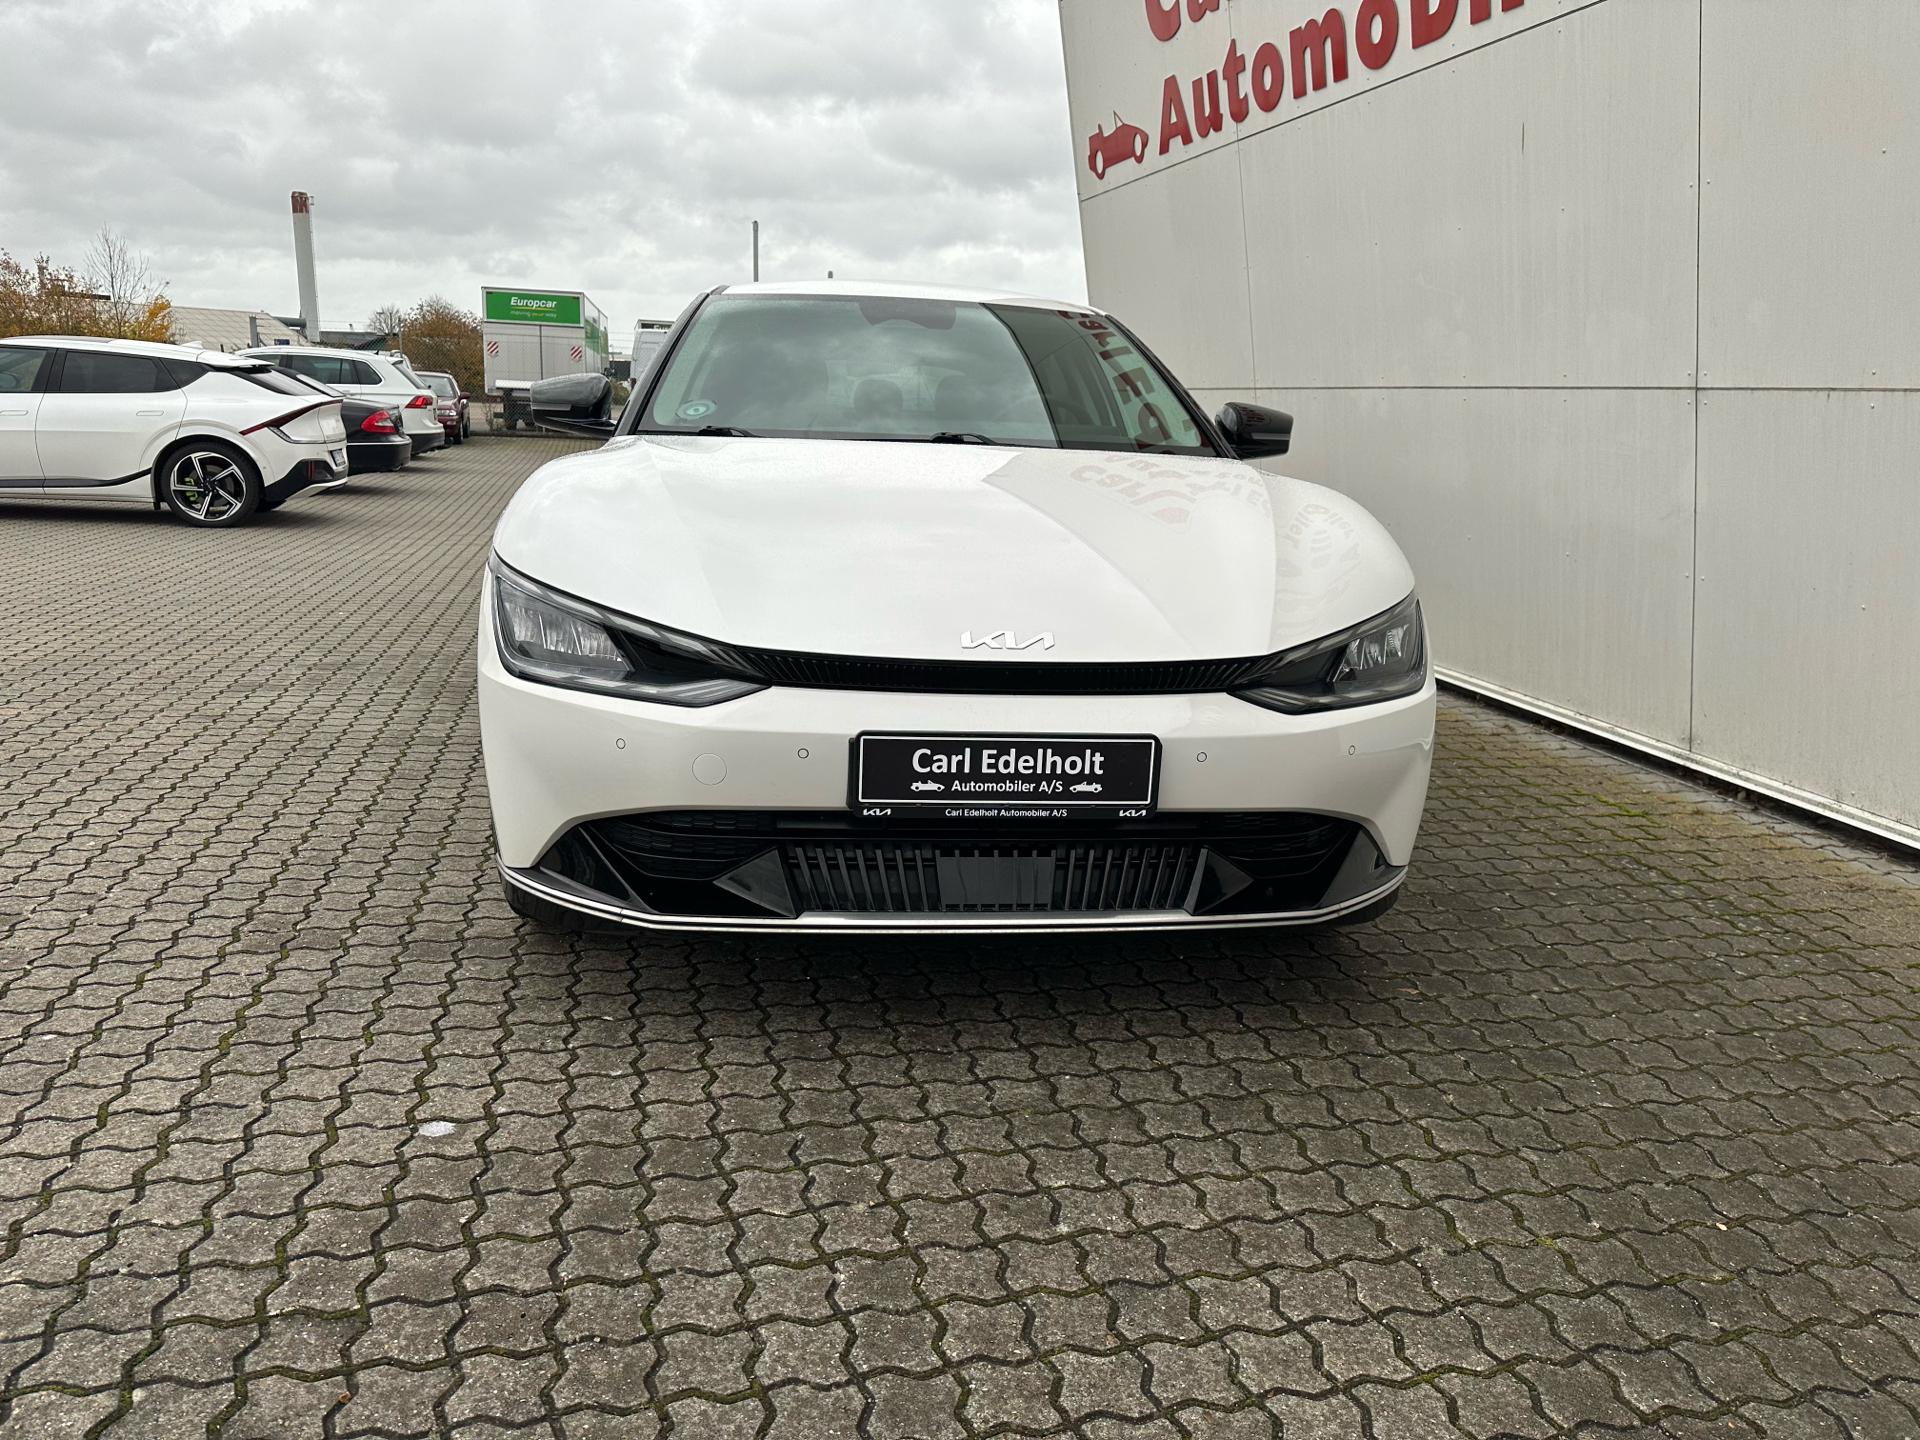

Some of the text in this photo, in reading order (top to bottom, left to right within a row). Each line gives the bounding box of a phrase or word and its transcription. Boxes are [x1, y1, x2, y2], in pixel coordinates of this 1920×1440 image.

[510, 296, 557, 310] Europcar
[912, 748, 1104, 775] Carl Edelholt
[952, 780, 1063, 794] Automobiler A/S
[945, 808, 1068, 818] Carl Edelholt Automobiler A/S
